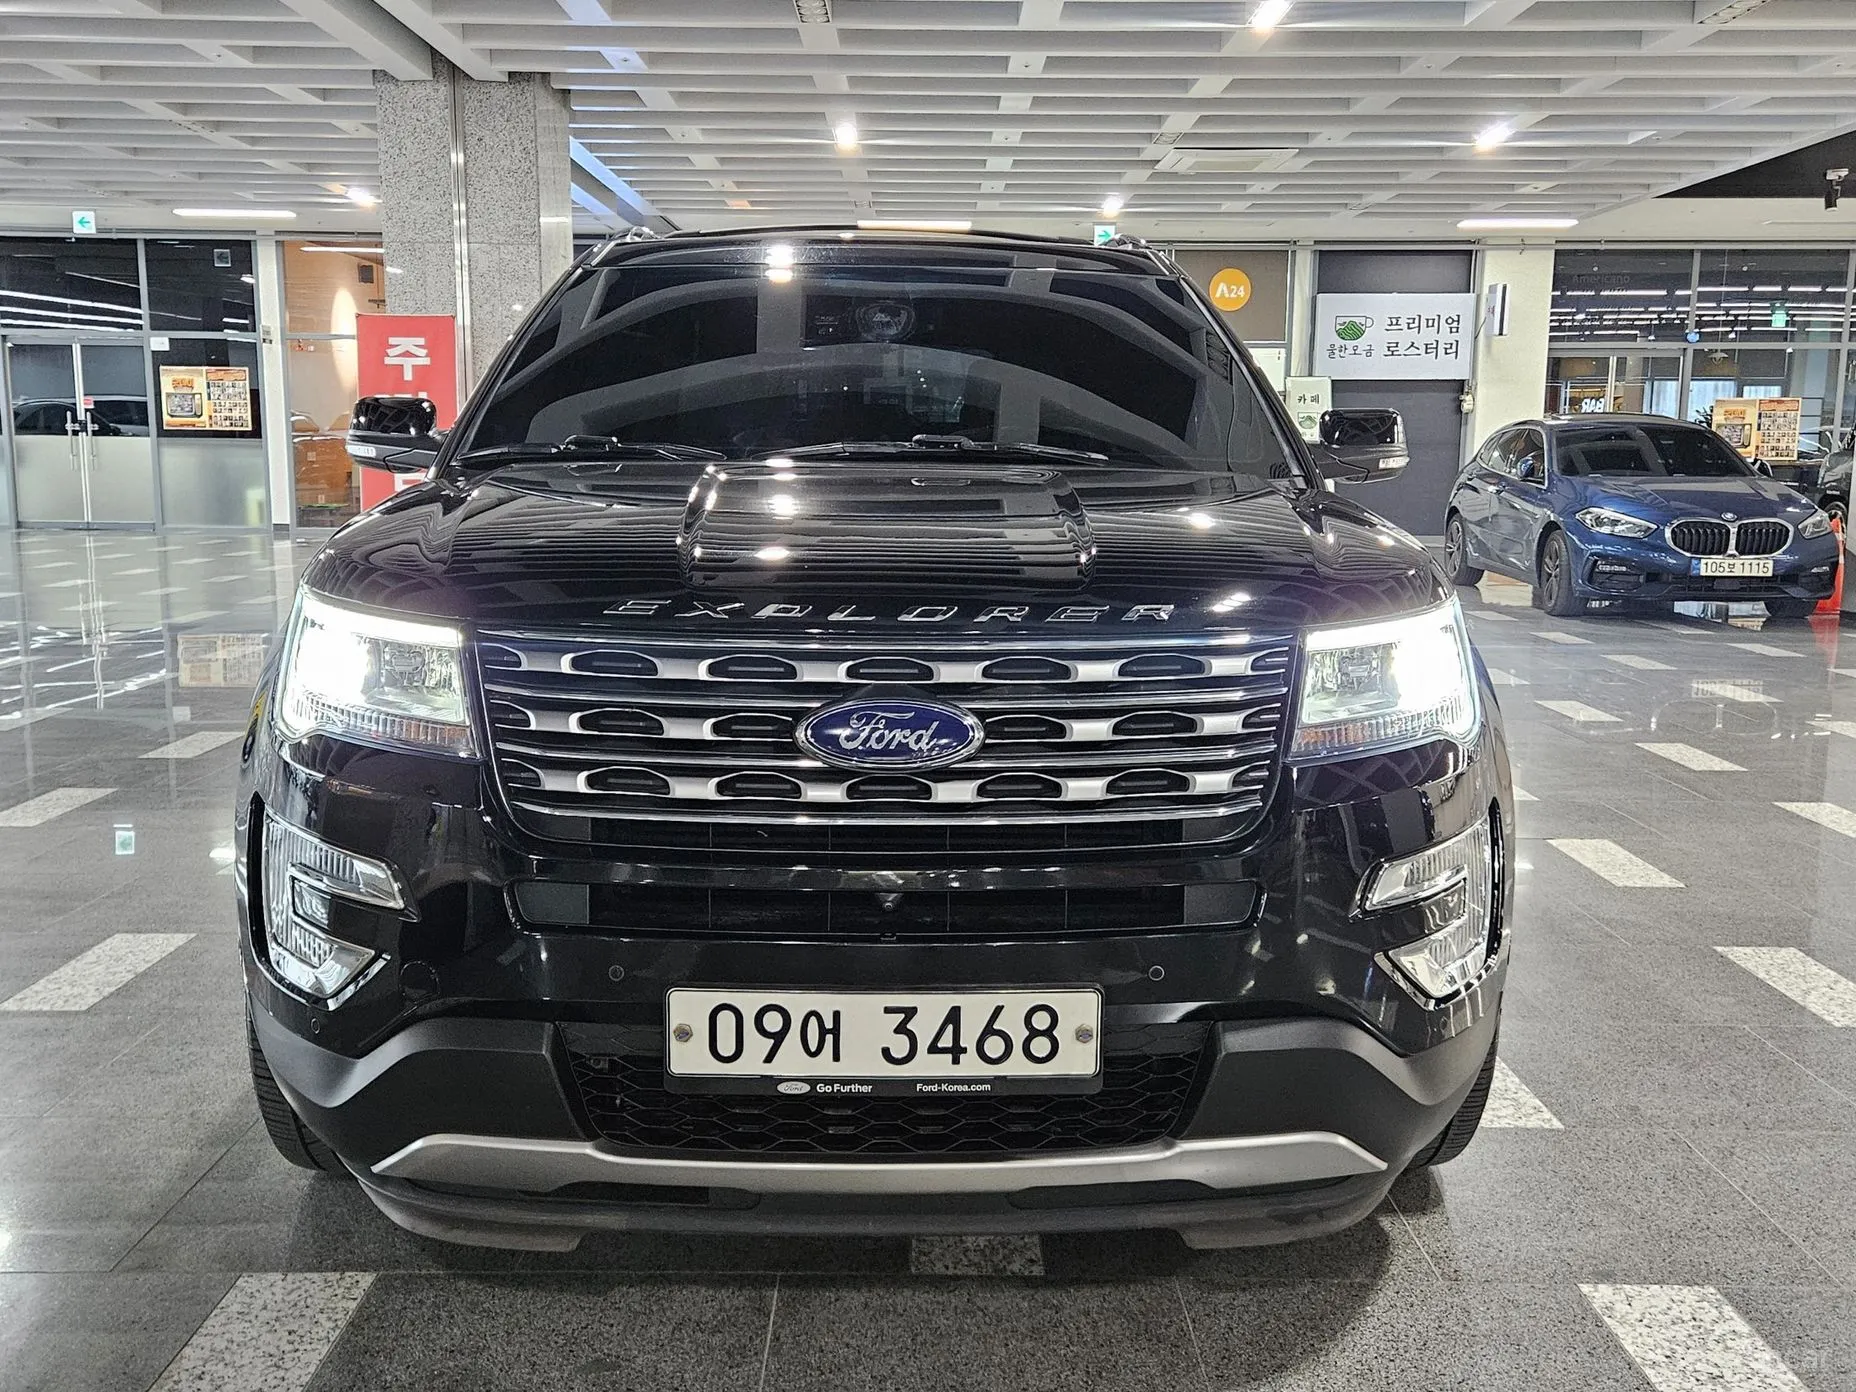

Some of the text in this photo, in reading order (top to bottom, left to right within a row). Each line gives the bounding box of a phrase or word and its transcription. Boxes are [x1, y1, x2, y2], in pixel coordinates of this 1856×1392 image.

[1384, 314, 1461, 334] 프리미엄
[1383, 340, 1460, 360] 로스터리
[1703, 561, 1770, 574] 105보 1115
[602, 599, 1176, 622] EXPLORER
[838, 711, 941, 751] Ford
[707, 1002, 1061, 1066] 09어 3468
[816, 1083, 833, 1092] Go
[833, 1083, 873, 1092] Further
[916, 1082, 991, 1092] Ford-Korea.com
